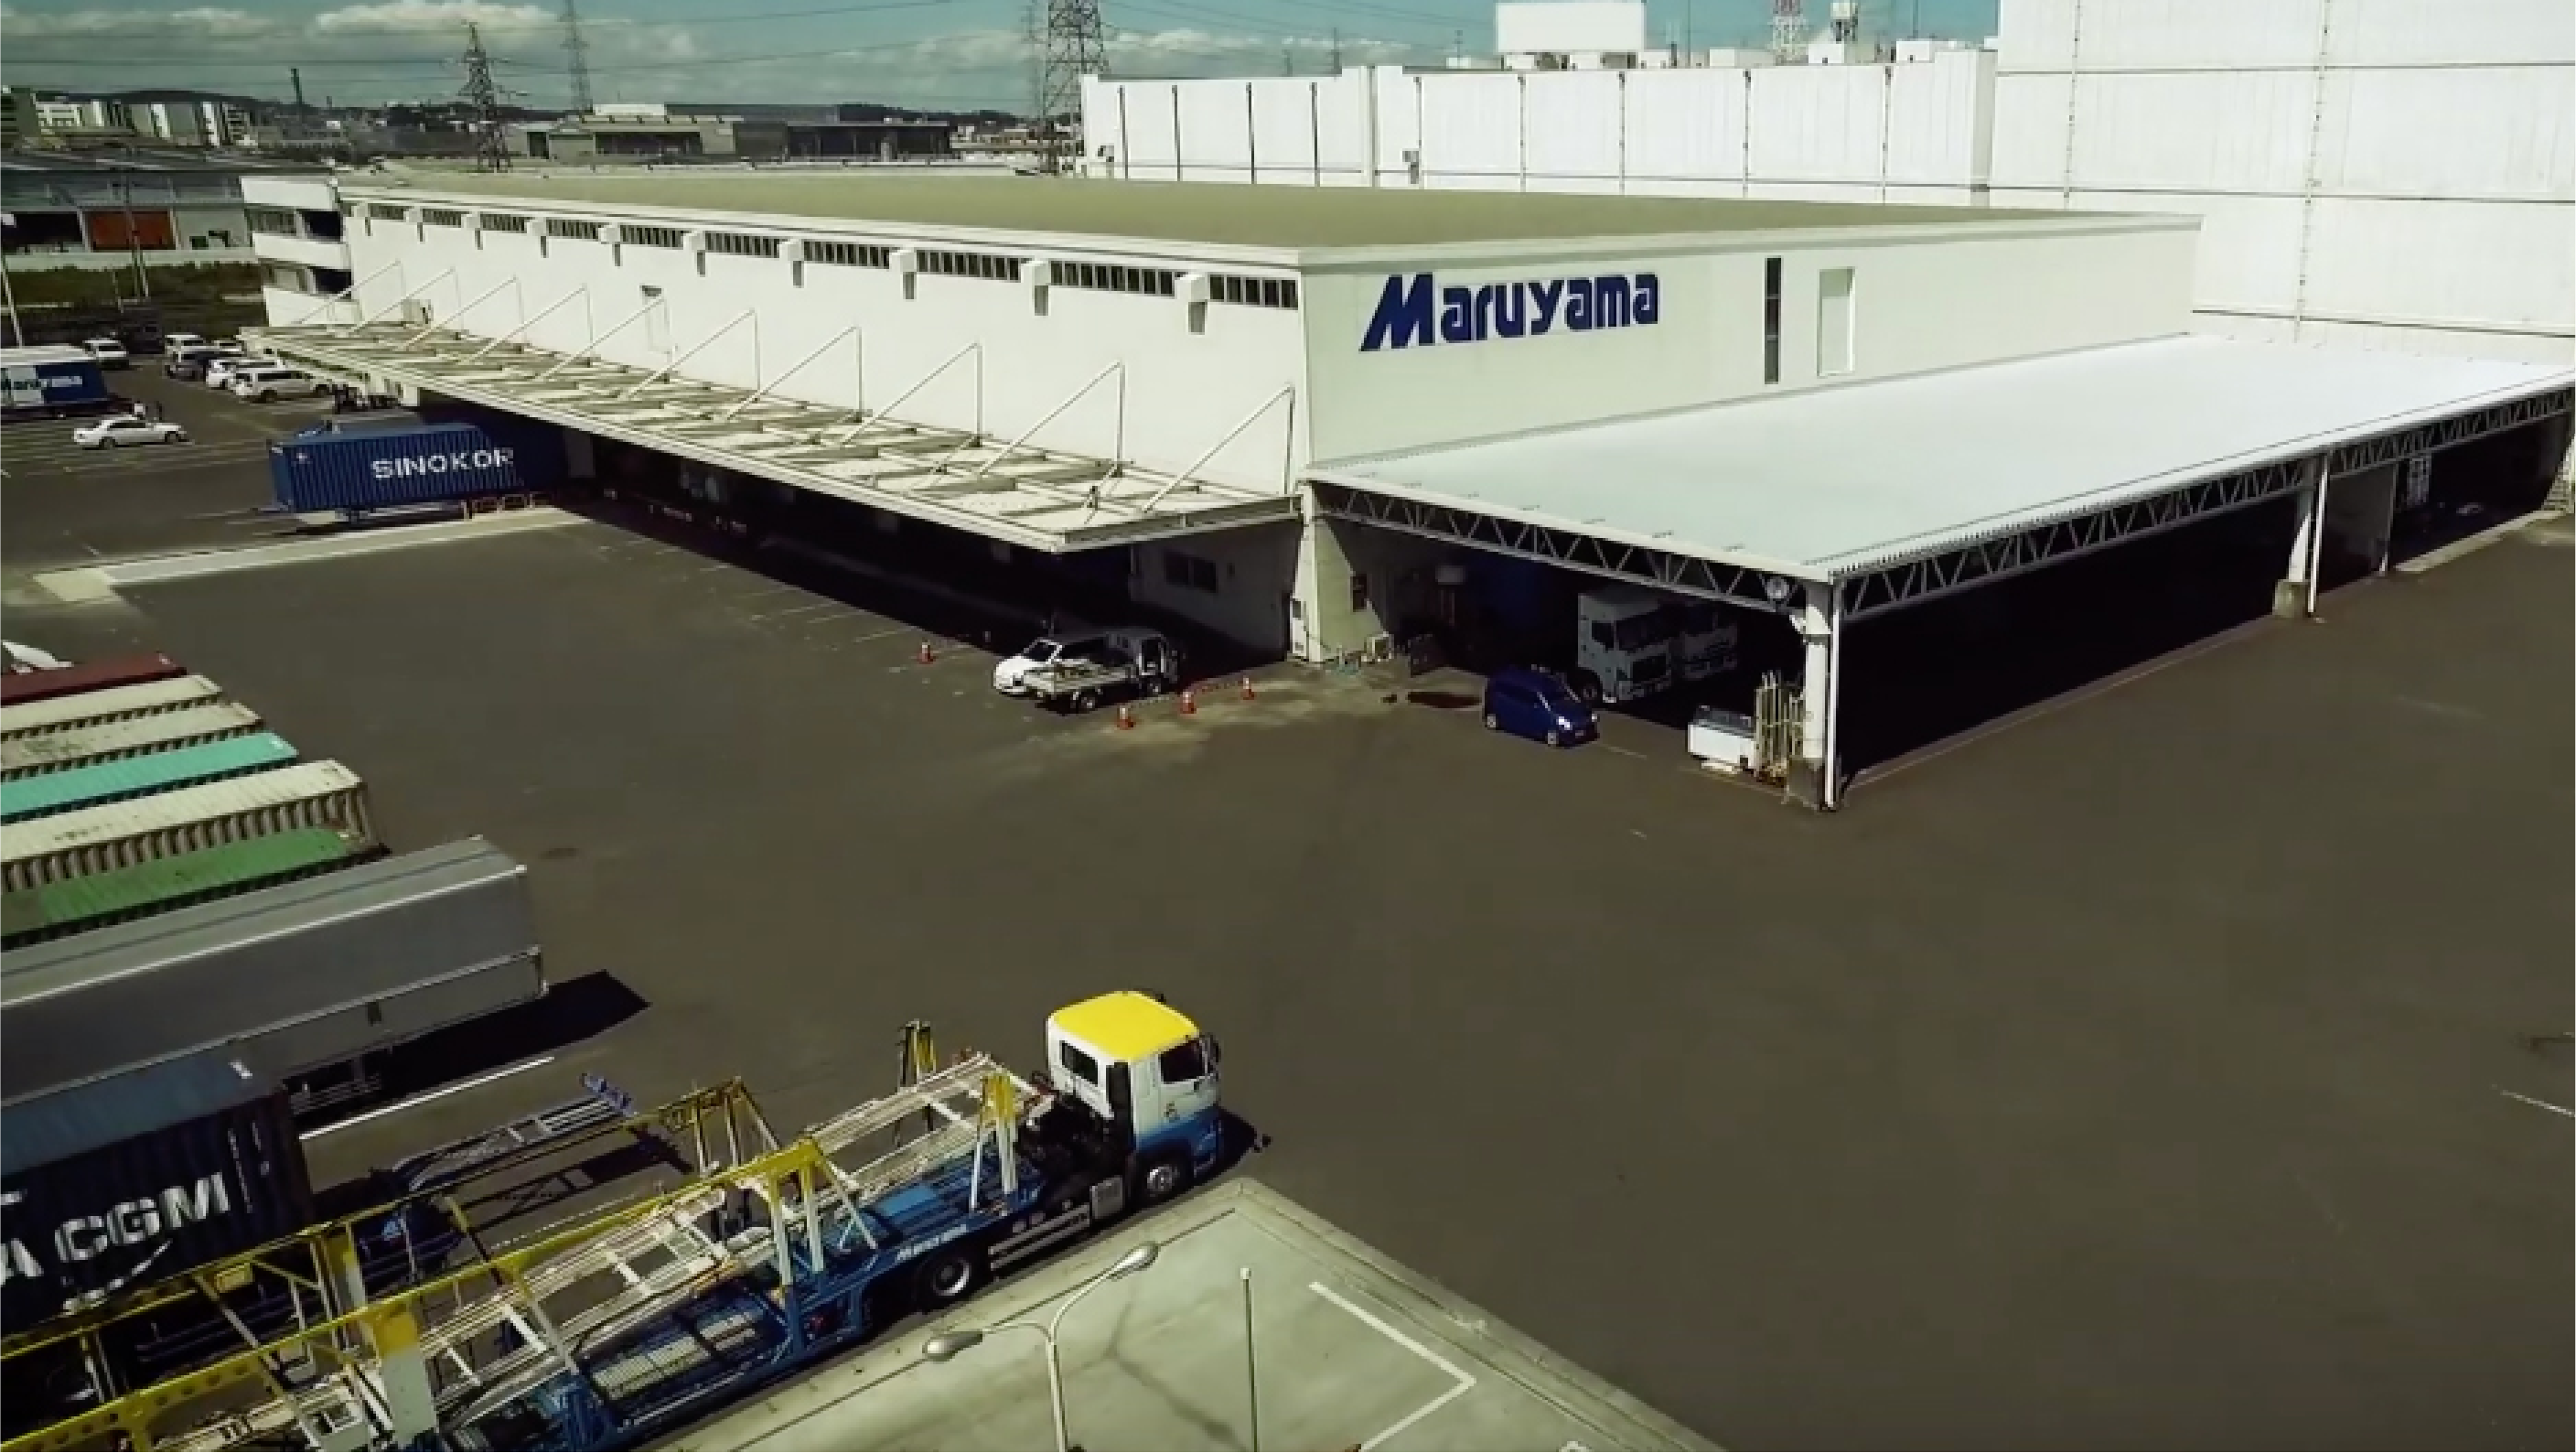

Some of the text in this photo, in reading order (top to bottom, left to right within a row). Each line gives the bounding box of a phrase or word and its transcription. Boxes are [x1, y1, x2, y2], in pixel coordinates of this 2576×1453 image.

[1358, 272, 1658, 351] Maruyama
[370, 447, 514, 479] SINOKOR
[55, 1172, 230, 1263] CGM
